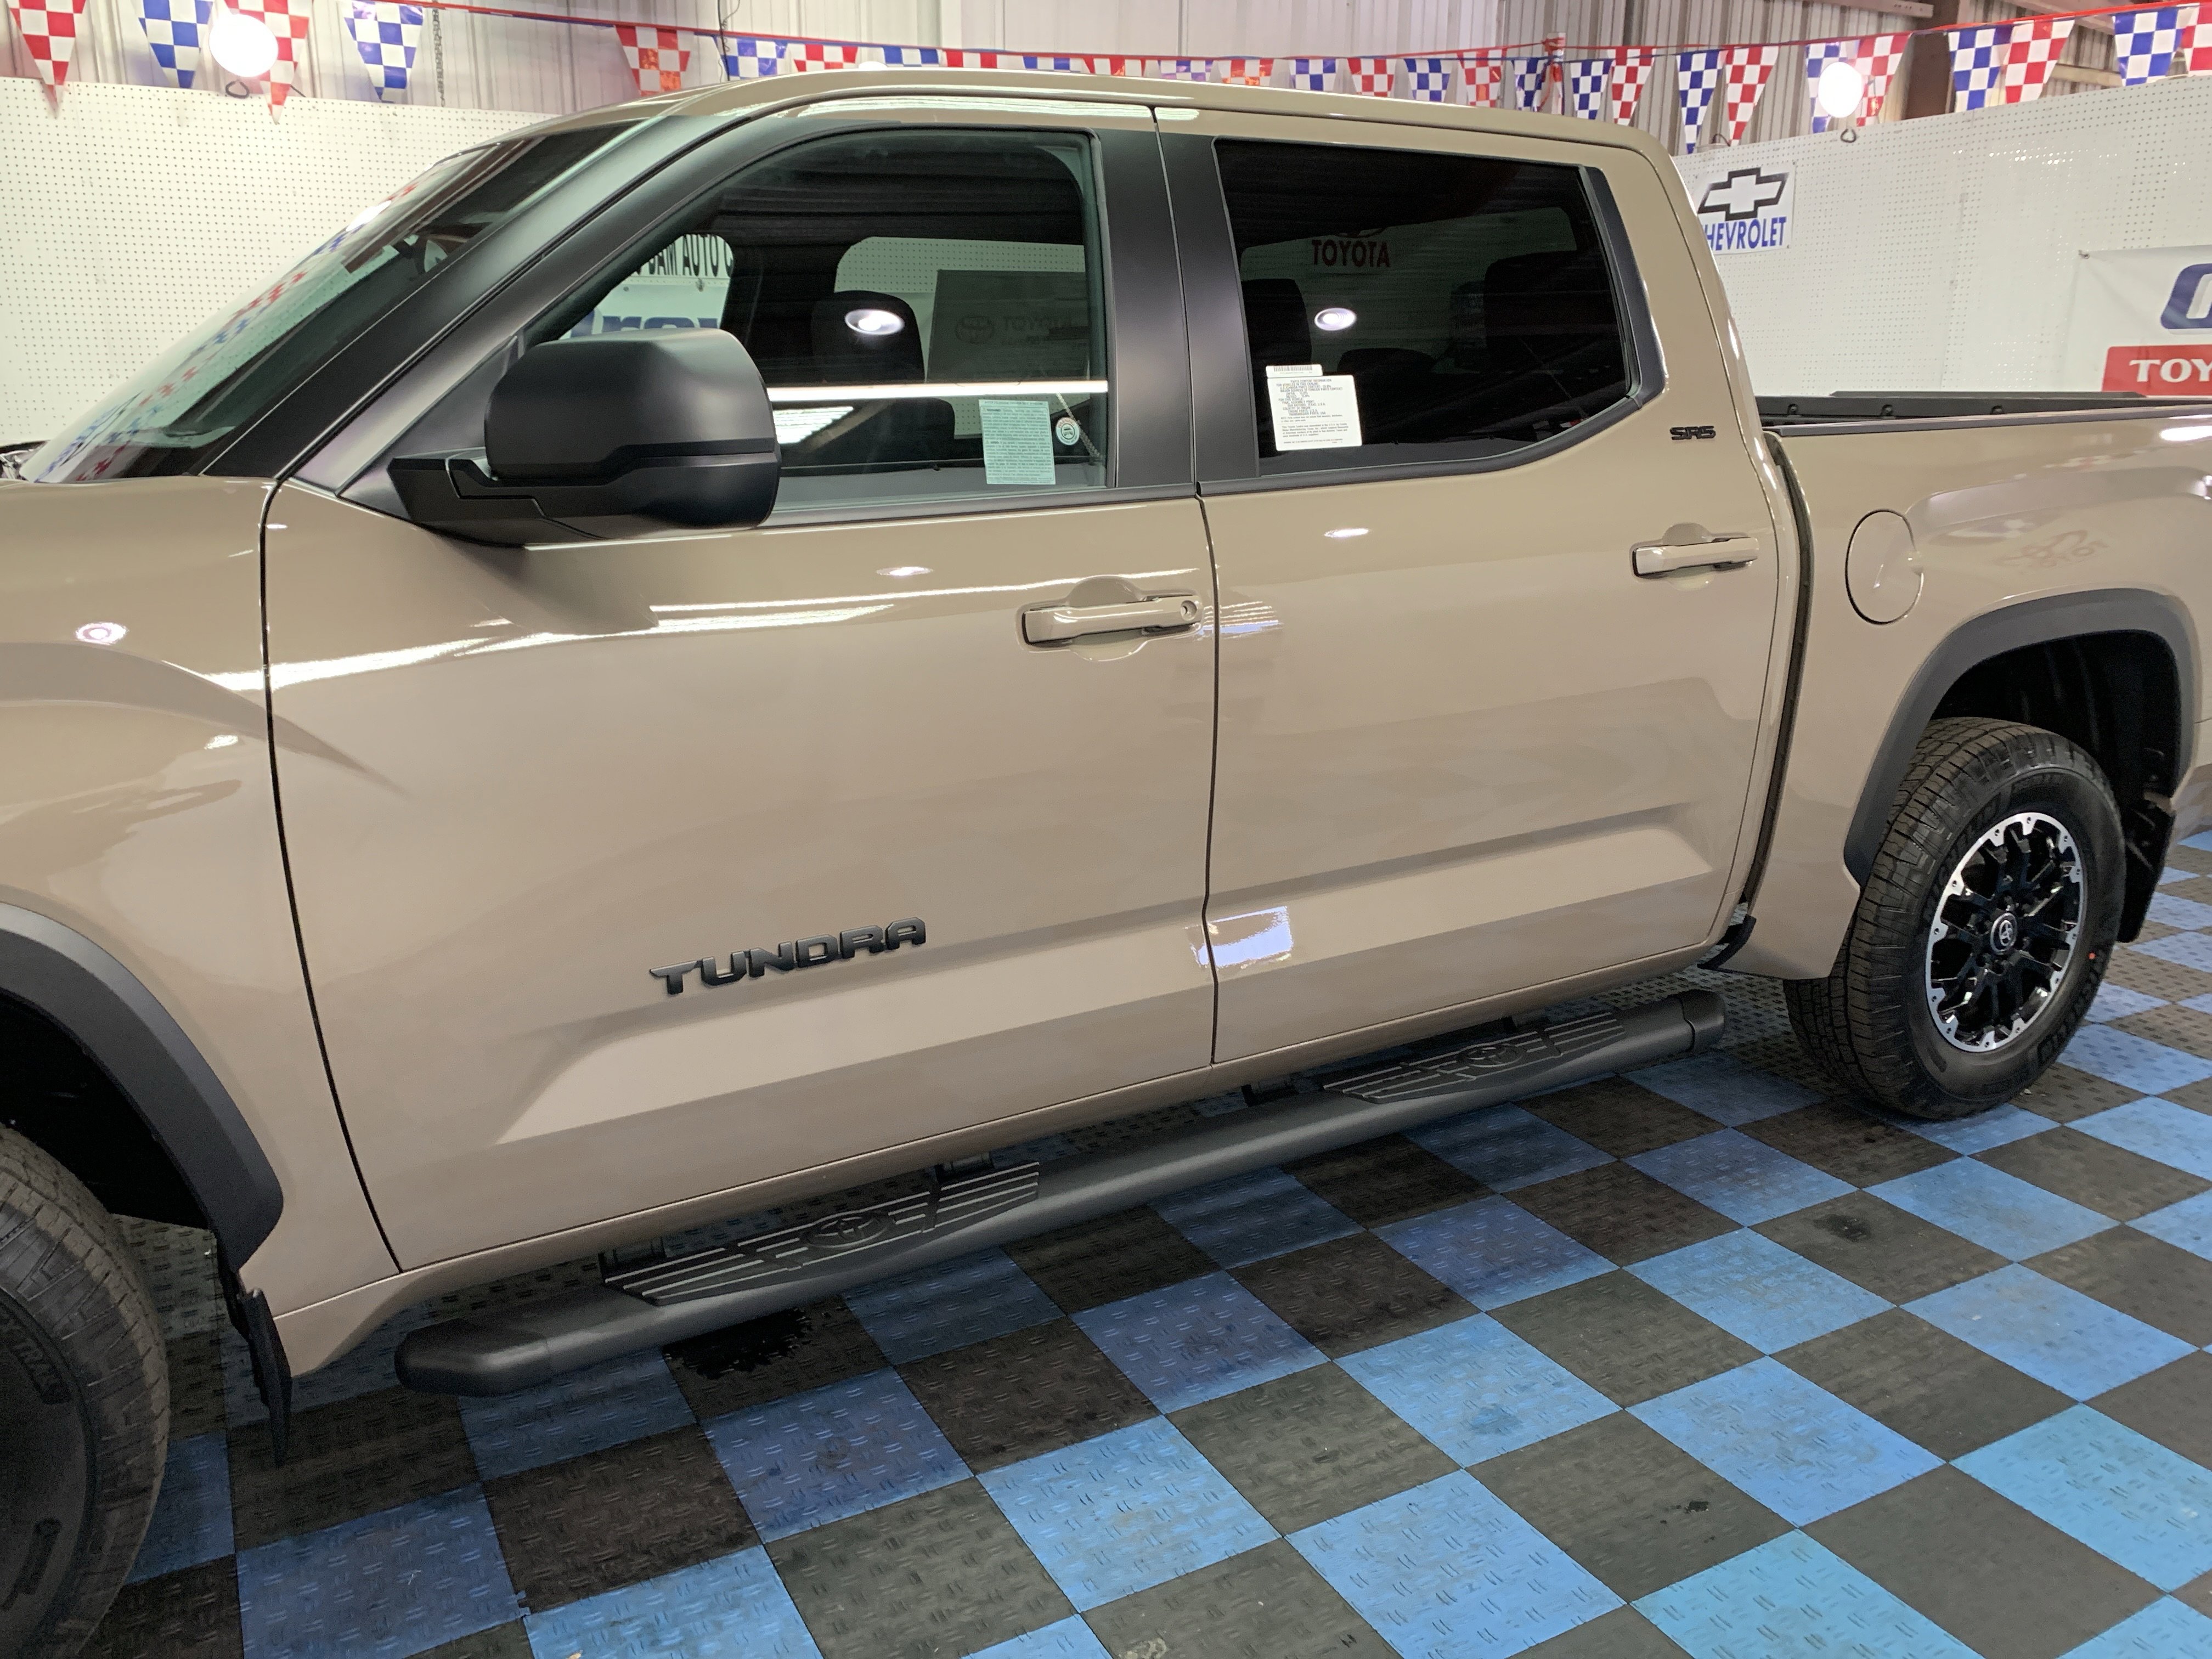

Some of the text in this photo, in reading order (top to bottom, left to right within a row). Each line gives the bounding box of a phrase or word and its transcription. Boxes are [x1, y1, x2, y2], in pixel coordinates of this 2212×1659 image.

[1705, 216, 1787, 251] HEVROLET
[1312, 239, 1391, 268] TOYOTA
[1669, 425, 1716, 440] SR5
[650, 916, 927, 995] TUNDRA
